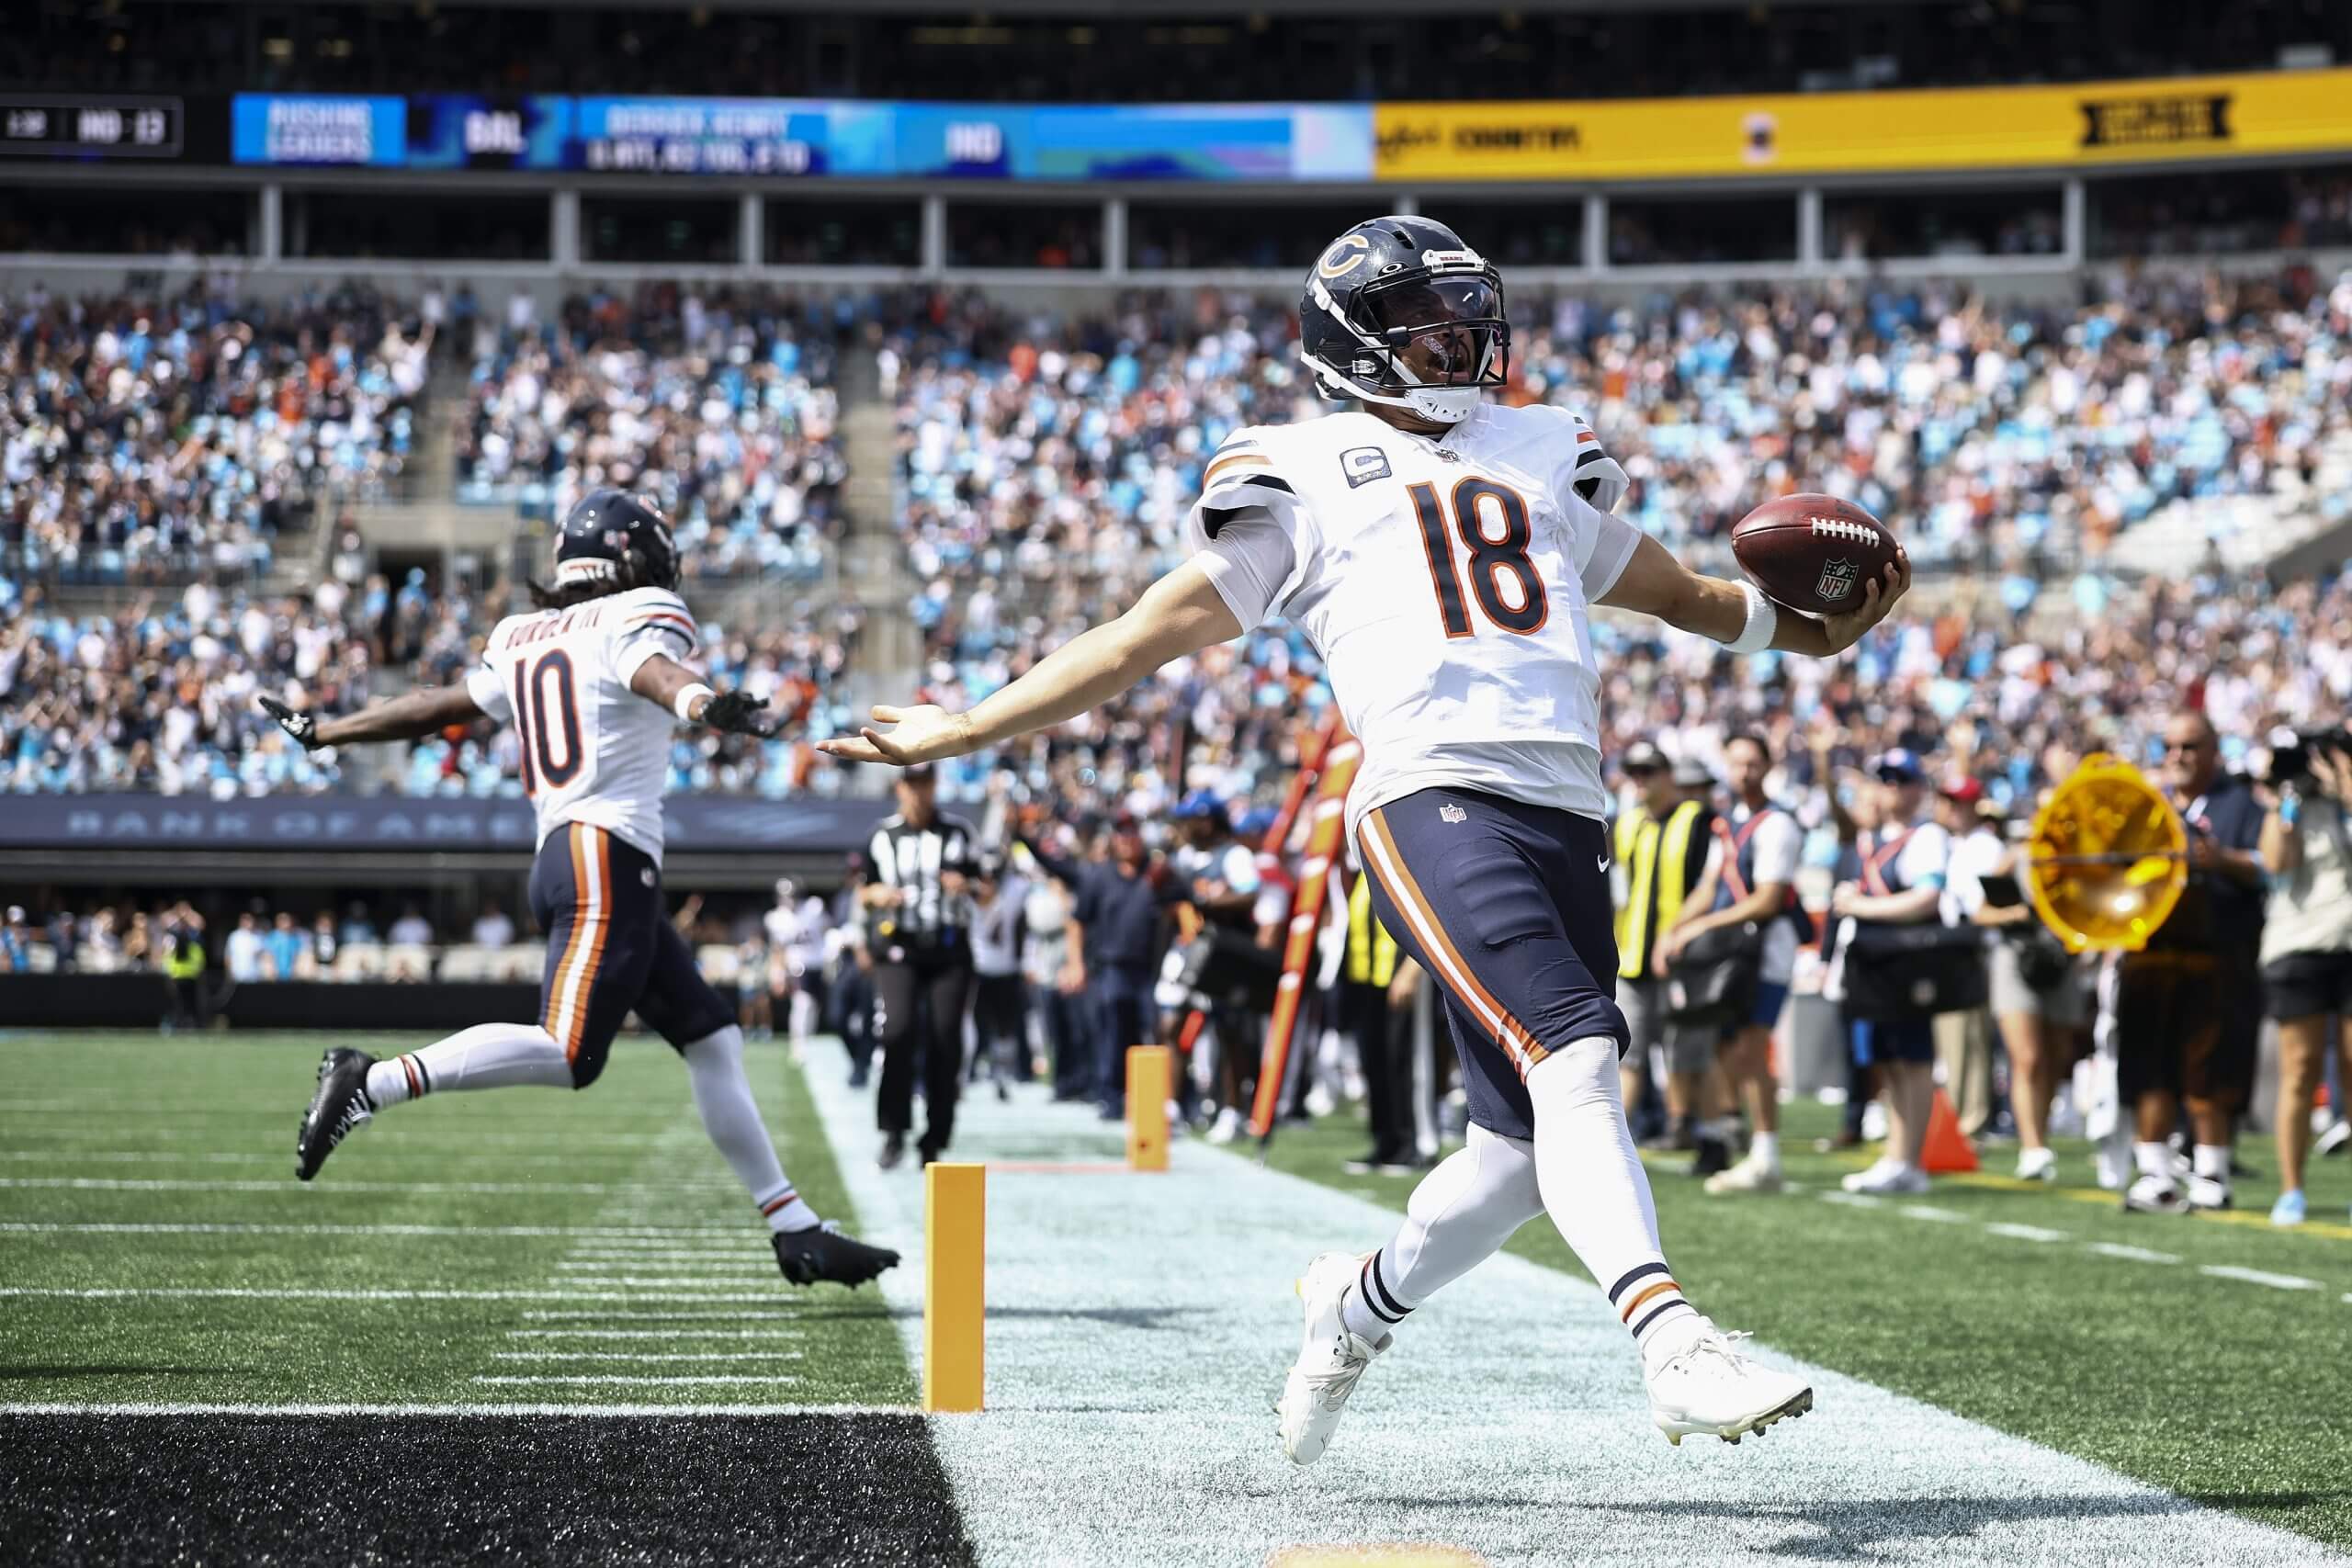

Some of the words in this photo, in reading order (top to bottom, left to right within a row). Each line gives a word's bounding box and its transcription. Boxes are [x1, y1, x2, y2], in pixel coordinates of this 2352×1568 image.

[1318, 234, 1369, 279] C
[1405, 475, 1550, 639] 18
[514, 647, 585, 798] 10
[68, 811, 250, 839] BANK
[272, 811, 356, 839] OF
